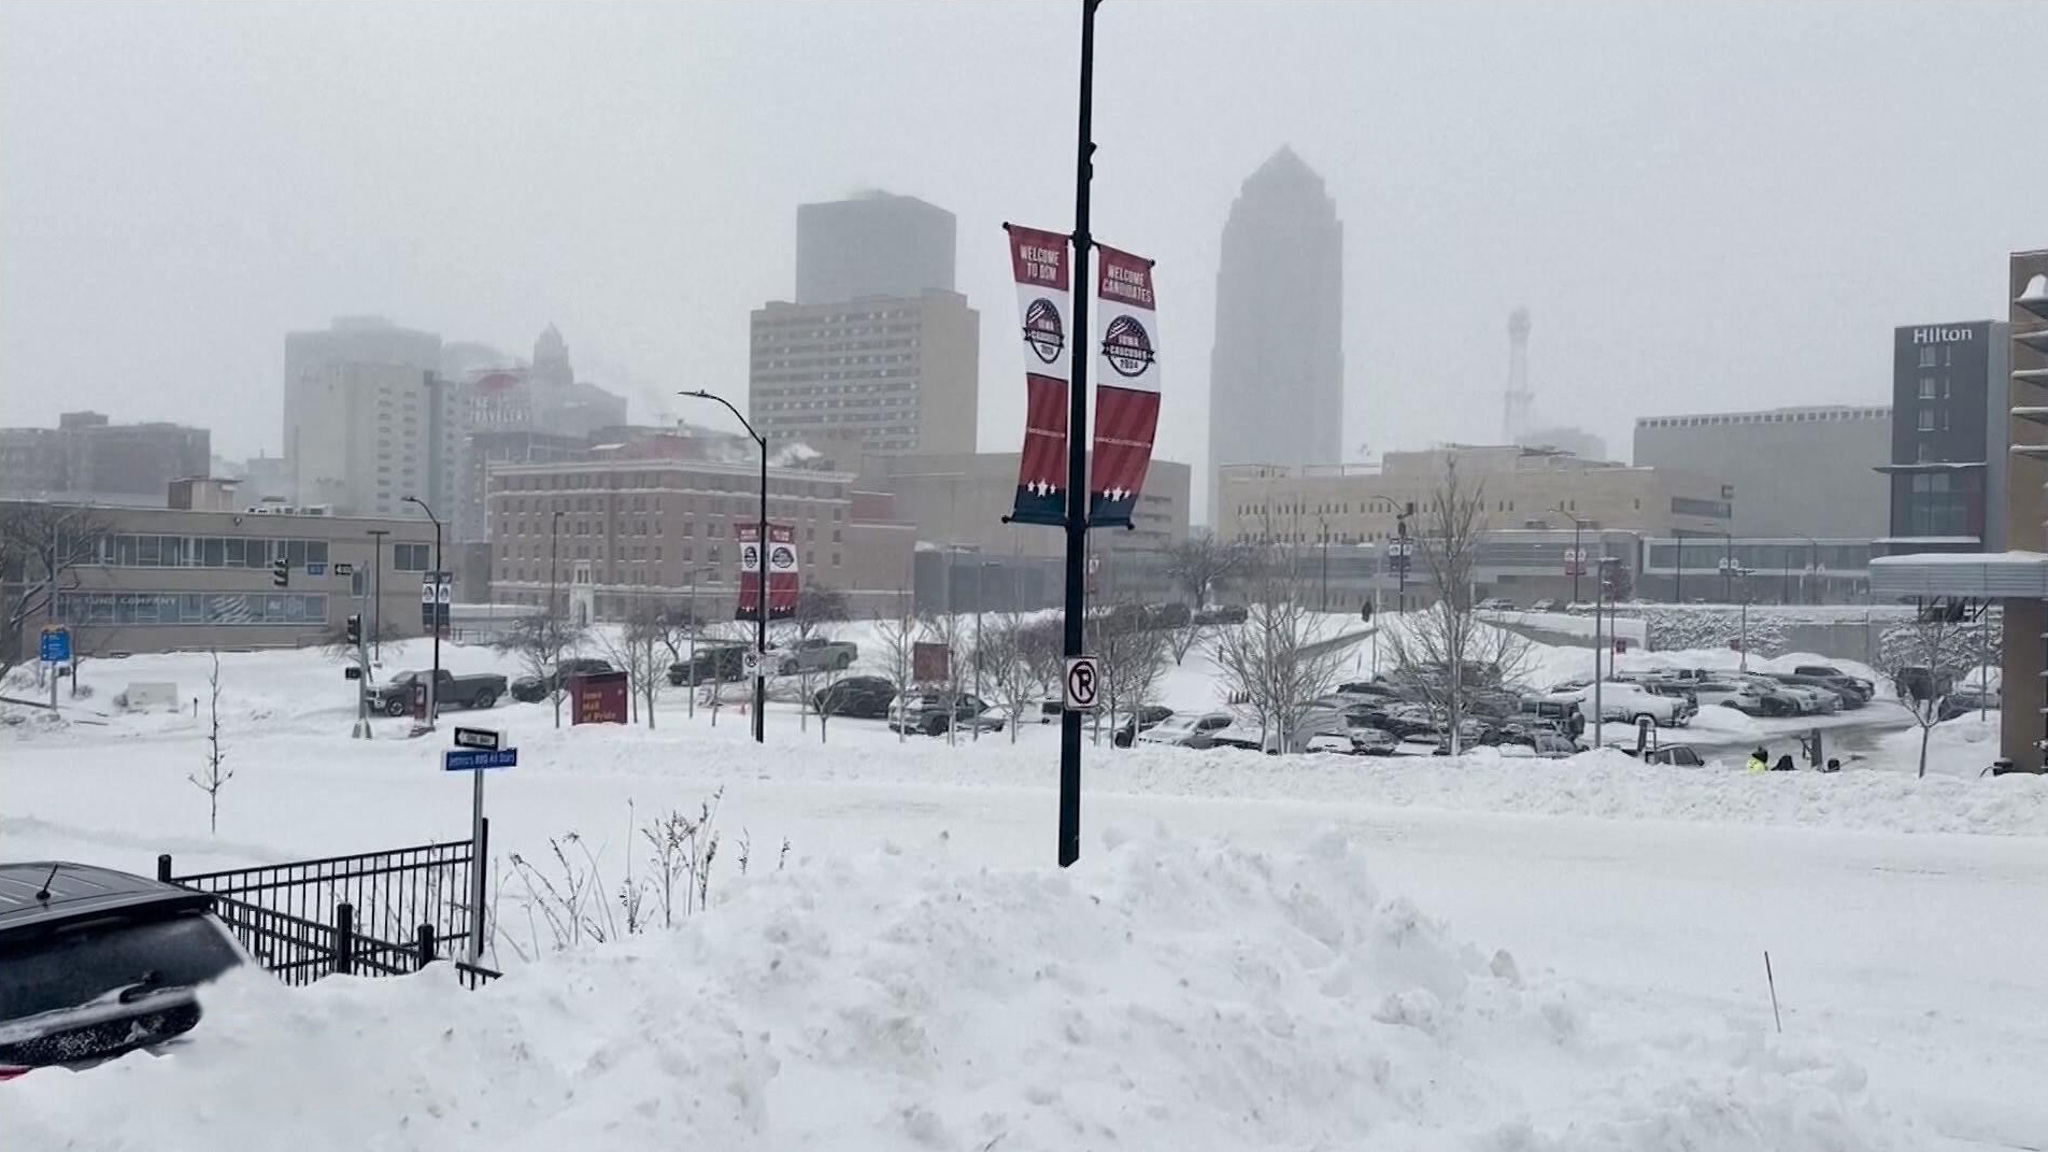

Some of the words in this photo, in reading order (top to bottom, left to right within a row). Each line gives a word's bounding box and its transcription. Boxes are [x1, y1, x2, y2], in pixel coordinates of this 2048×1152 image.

[1020, 244, 1060, 266] WELCOME
[1027, 262, 1039, 277] TO
[1039, 264, 1057, 281] DSM
[1107, 263, 1145, 287] WELCOME
[1102, 277, 1152, 303] CANDIDATES
[1118, 334, 1139, 347] IOWA
[1913, 327, 1972, 343] Hilton
[1109, 345, 1149, 360] CAUCUSES
